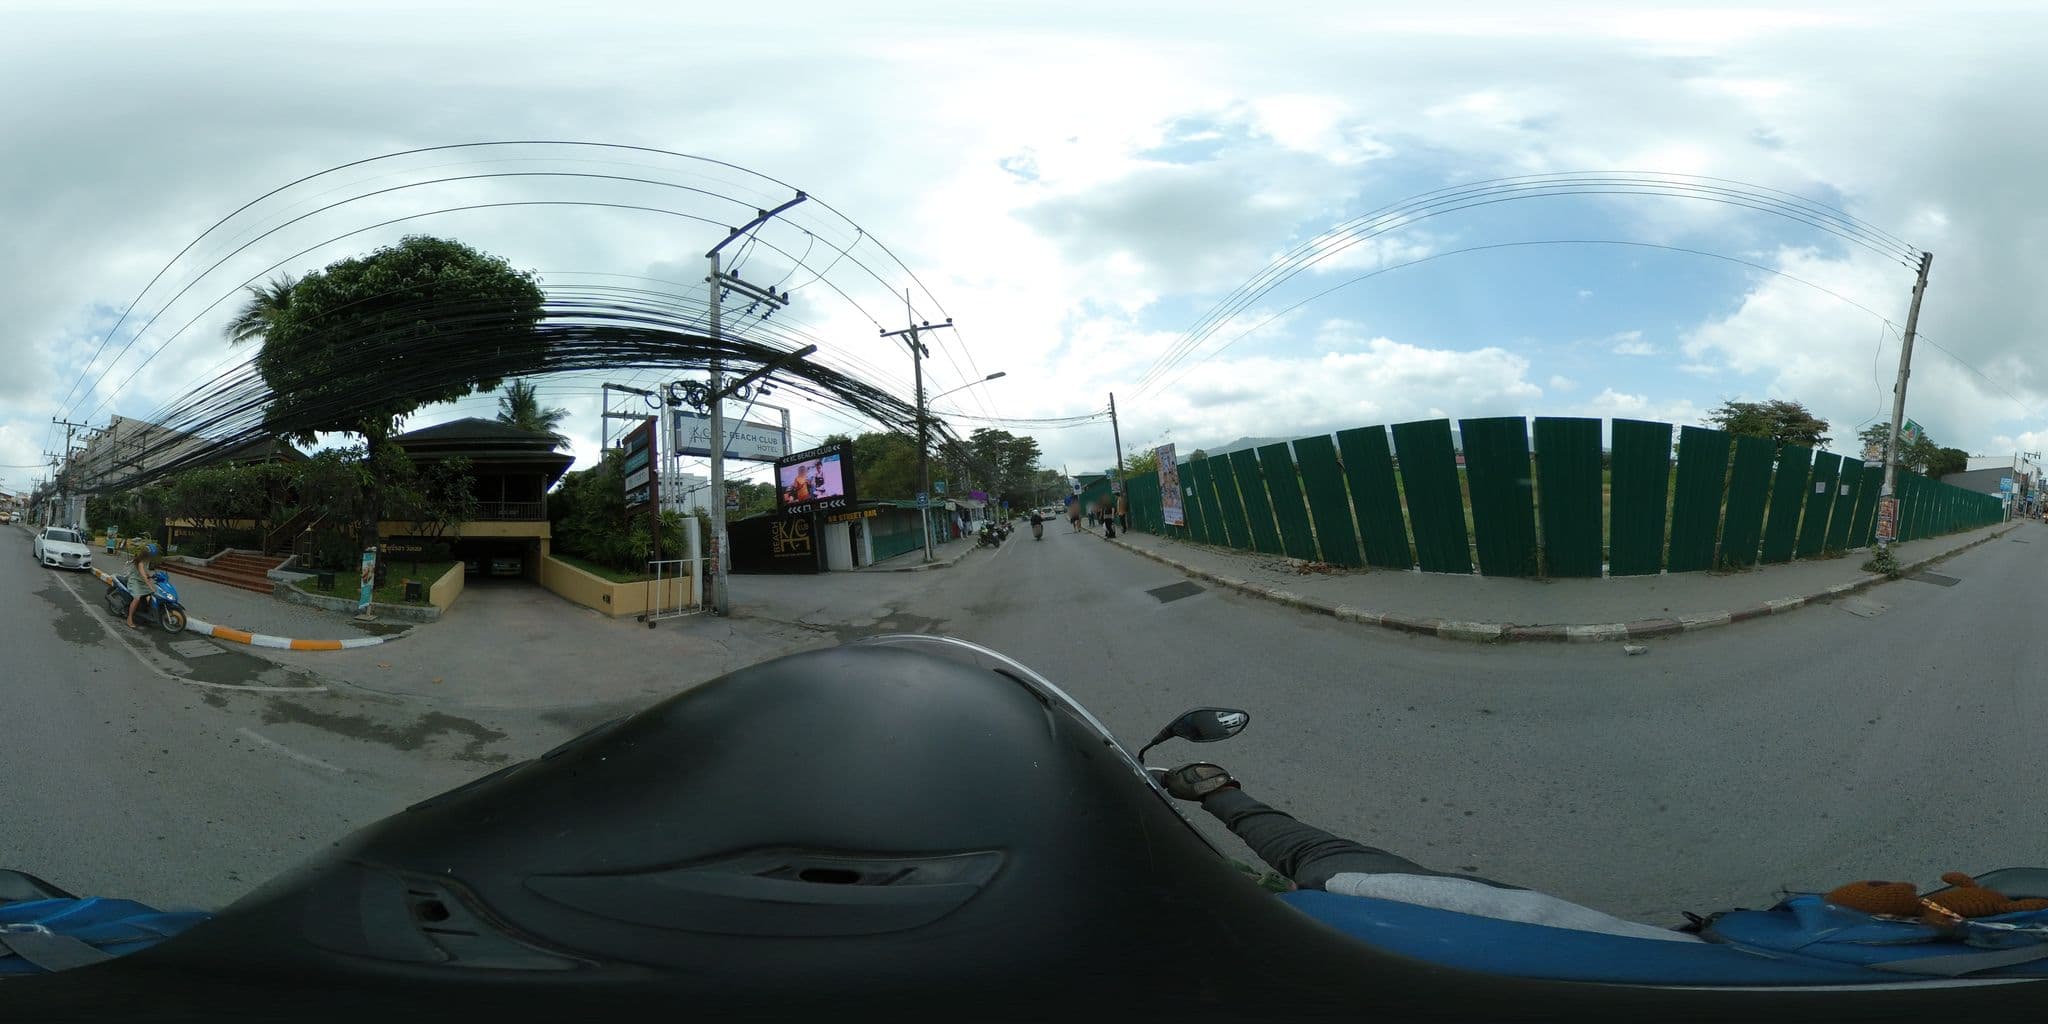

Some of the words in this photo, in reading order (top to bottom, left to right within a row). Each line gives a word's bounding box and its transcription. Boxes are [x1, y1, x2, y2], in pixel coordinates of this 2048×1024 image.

[730, 431, 757, 442] BEACH
[758, 436, 778, 445] CLUB
[757, 444, 778, 453] HOTEL
[797, 449, 816, 460] BEACH
[816, 446, 832, 455] CLUB
[770, 521, 780, 553] BEACH
